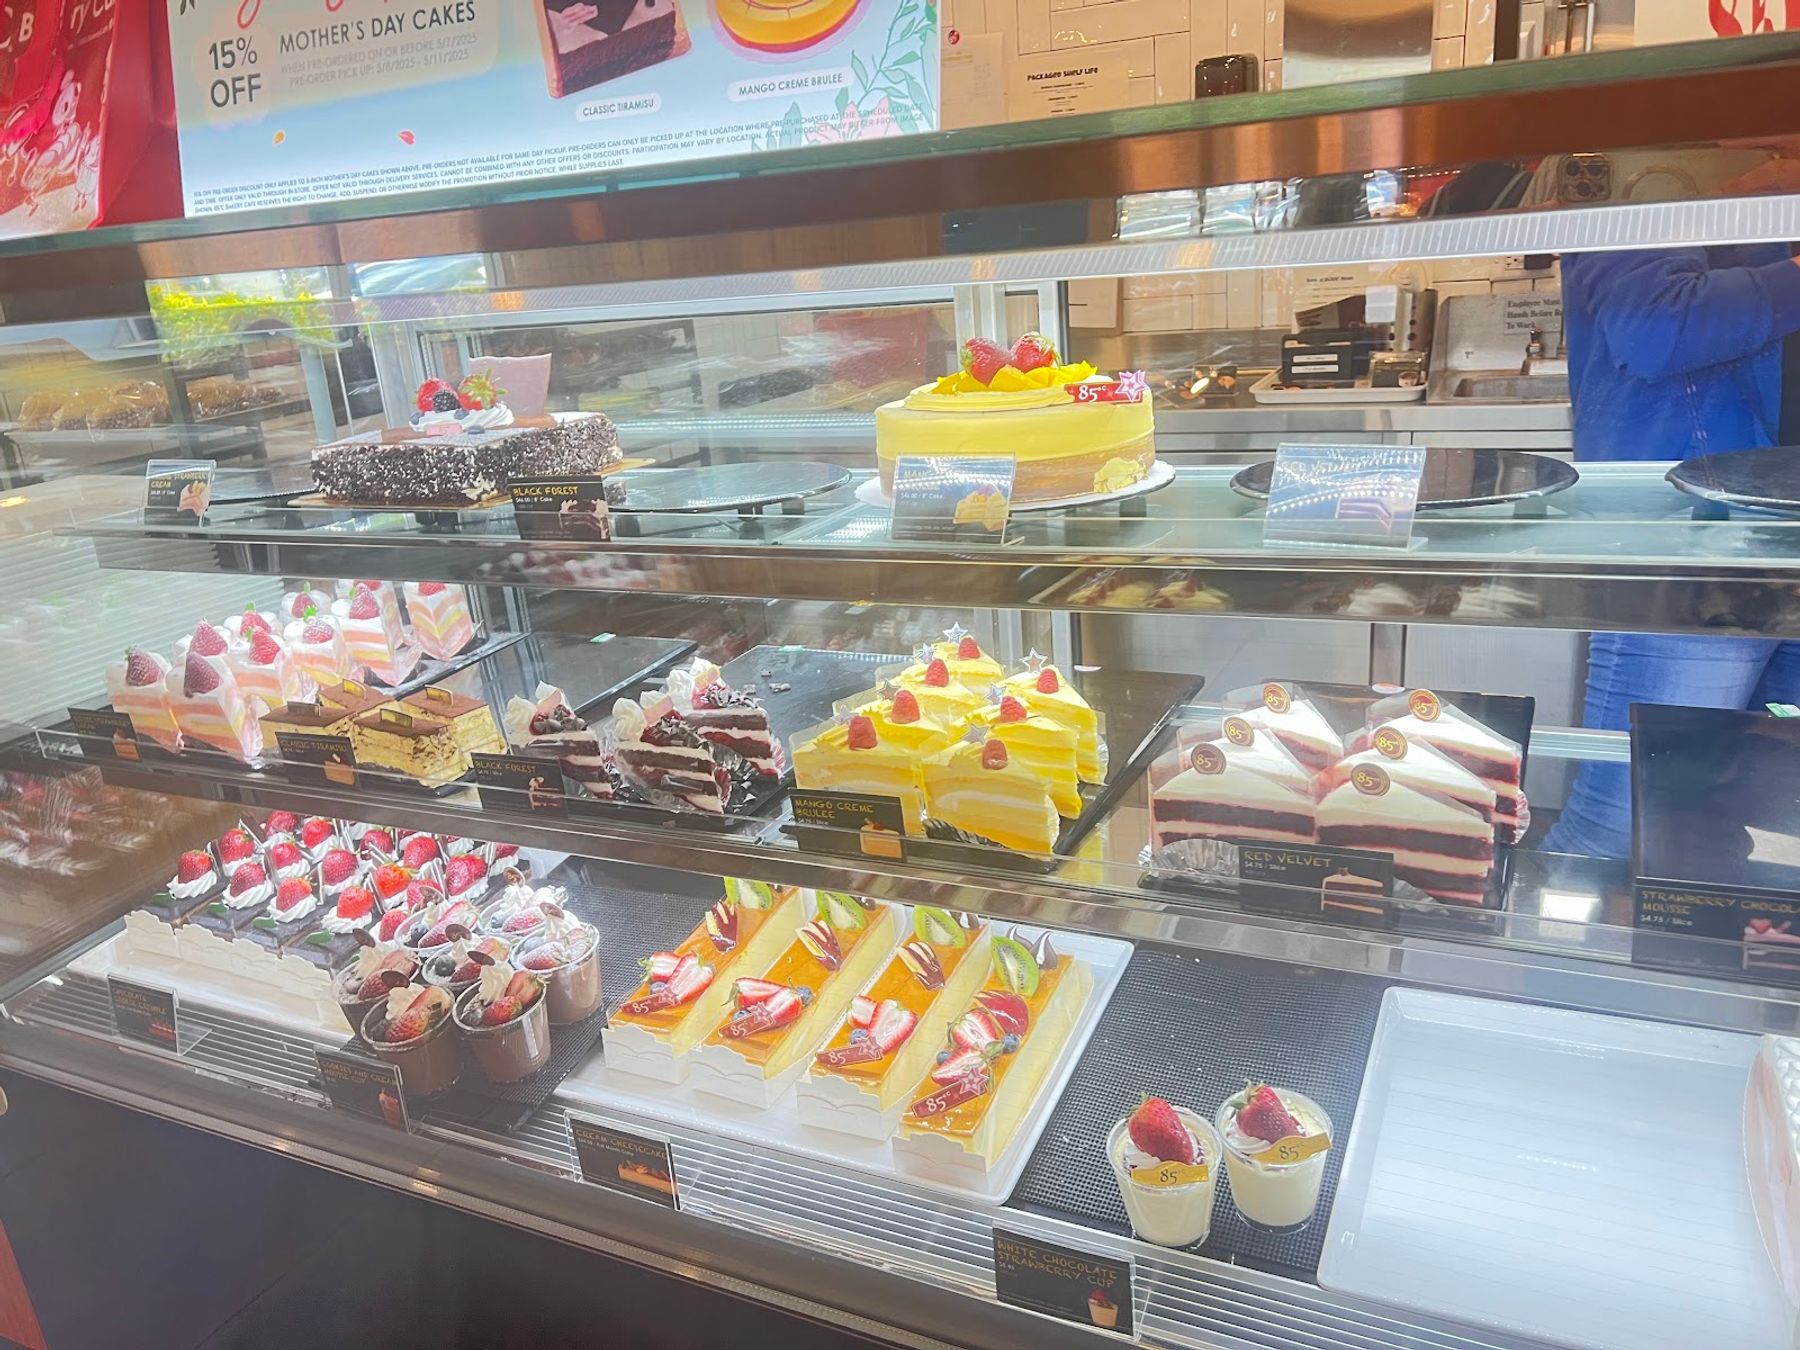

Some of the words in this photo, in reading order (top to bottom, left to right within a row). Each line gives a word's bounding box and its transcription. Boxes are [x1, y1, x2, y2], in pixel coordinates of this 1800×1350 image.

[279, 20, 365, 54] MOTHER'S
[371, 12, 405, 38] DAY
[412, 0, 476, 30] CAKES
[208, 36, 258, 70] 15%
[367, 49, 386, 60] ON
[400, 42, 435, 55] BEFORE
[435, 32, 478, 49] 5/7/2025
[289, 71, 337, 88] PRE-ORDER
[337, 66, 360, 80] PICK
[738, 83, 777, 97] MANGO
[778, 77, 810, 92] CREME
[810, 72, 844, 87] BRULEE
[210, 73, 262, 108] OFF
[582, 102, 616, 117] CLASSIC
[616, 98, 655, 112] TIRAMISU
[470, 155, 500, 163] AVAILABLE
[709, 125, 744, 134] LOCATION
[744, 122, 770, 130] WHERE
[439, 168, 465, 176] CANNOT
[474, 163, 504, 172] COMBINED
[535, 157, 556, 165] OTHER
[557, 154, 581, 162] OFFERS
[631, 142, 680, 153] PARTICIPATION
[696, 138, 715, 146] VARY
[452, 175, 487, 184] PROMOTION
[487, 172, 515, 180] WITHOUT
[514, 169, 534, 177] PRIOR
[557, 164, 578, 172] WHILE
[578, 161, 607, 170] SUPPLIES
[512, 487, 542, 496] BLACK
[544, 486, 578, 495] FOREST
[474, 760, 503, 770] BLACK
[505, 762, 537, 774] FOREST
[795, 799, 833, 810] MANGO
[836, 801, 874, 813] CREME
[795, 808, 836, 819] BRULEE
[1244, 851, 1273, 862] RED
[1277, 852, 1332, 868] VELVET
[1641, 890, 1737, 908] STRAWBERRY
[1642, 902, 1691, 915] MOUSSE
[1640, 914, 1664, 923] $4.75
[1672, 916, 1694, 926] Slice
[575, 1129, 608, 1144] CREAM
[997, 1240, 1037, 1259] WHITE
[1043, 1253, 1118, 1280] CHOCOLATE
[997, 1250, 1081, 1280] STRAWBERRY
[1087, 1276, 1114, 1289] CUP
